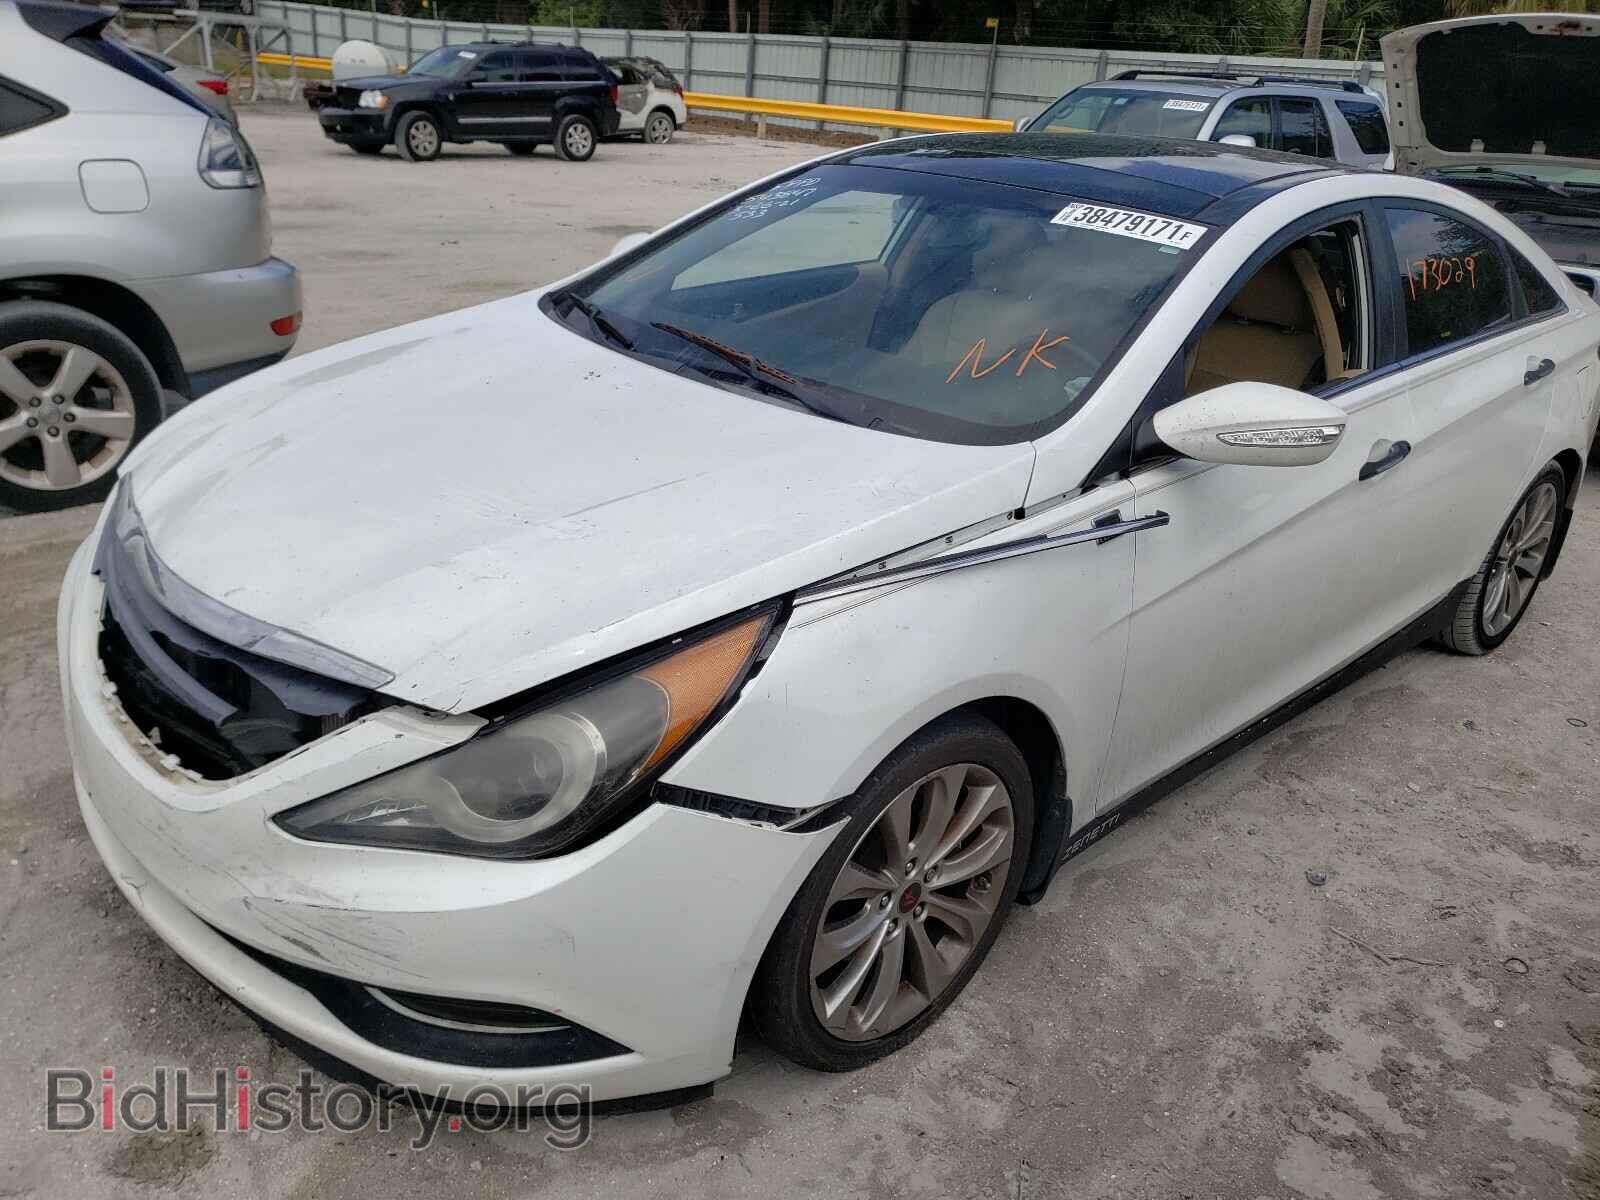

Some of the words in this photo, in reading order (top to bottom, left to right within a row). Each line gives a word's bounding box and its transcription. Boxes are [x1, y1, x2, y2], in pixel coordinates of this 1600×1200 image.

[1074, 206, 1184, 240] 38479171
[1179, 232, 1192, 241] F
[1406, 255, 1477, 301] 173029
